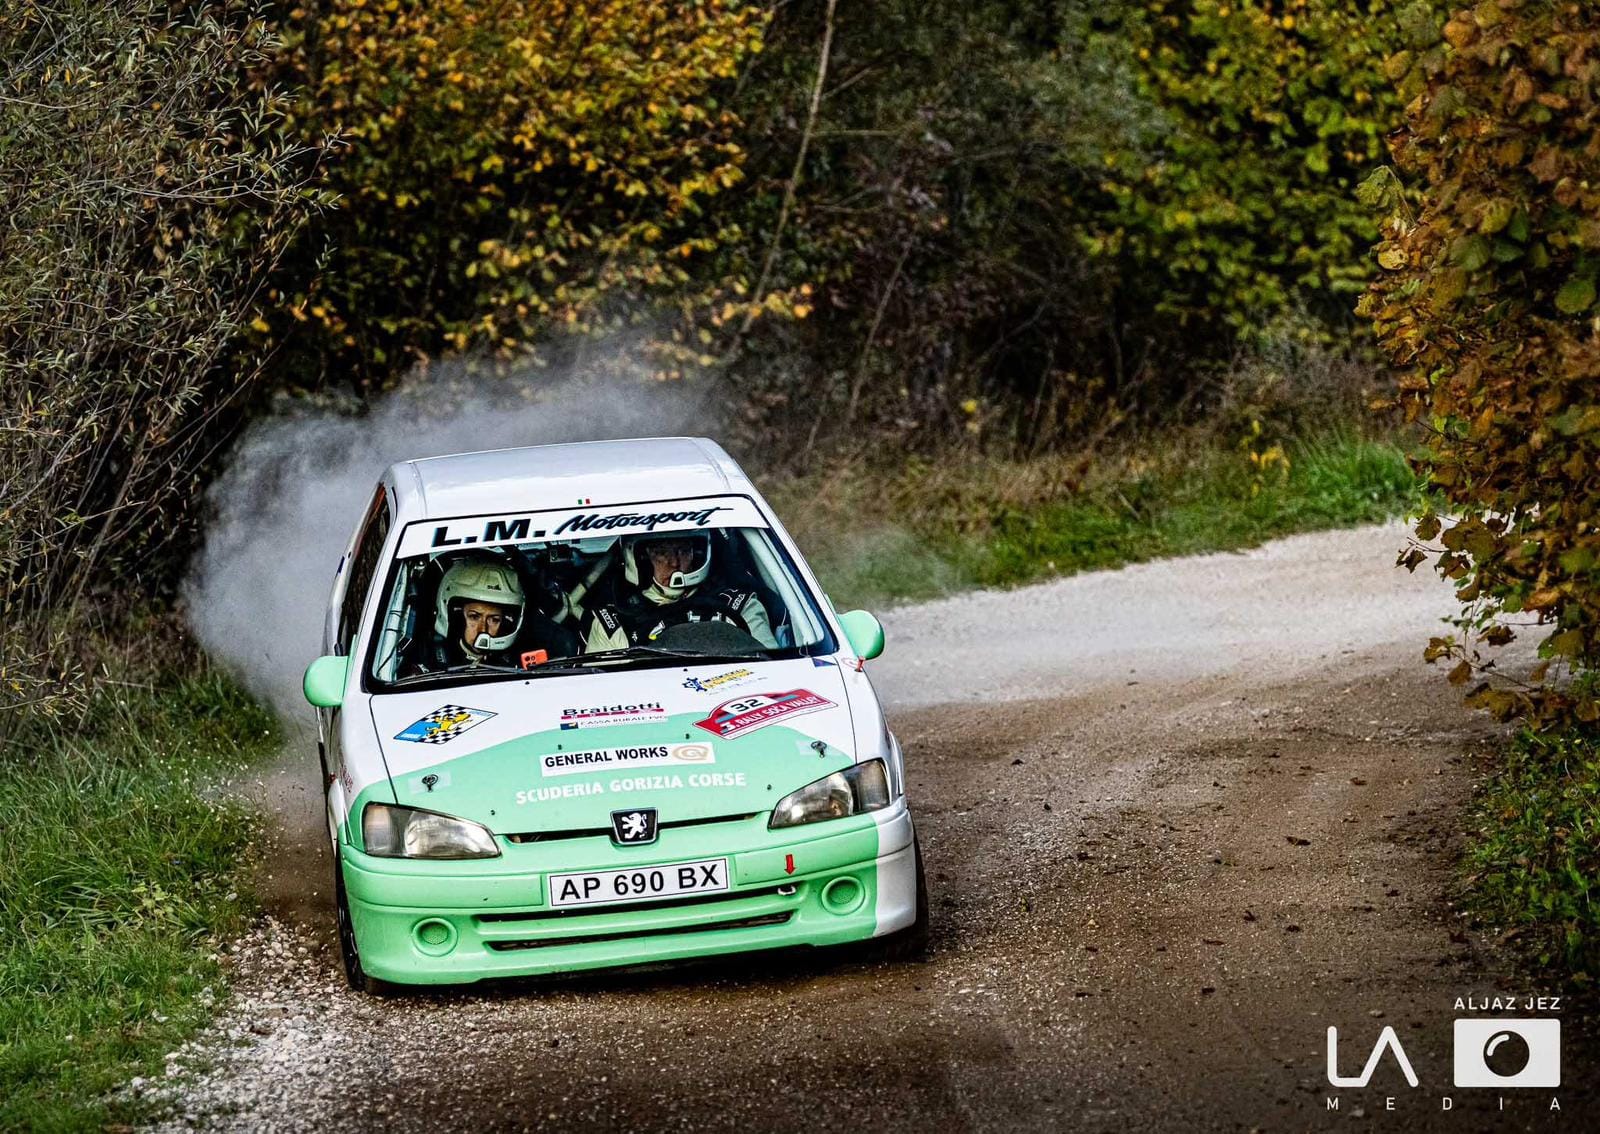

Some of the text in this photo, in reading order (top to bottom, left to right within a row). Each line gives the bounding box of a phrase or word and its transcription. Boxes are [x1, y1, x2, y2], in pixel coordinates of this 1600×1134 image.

[431, 507, 734, 548] L.M. Motorsport
[563, 702, 660, 716] Braidotti
[731, 699, 764, 712] 32
[735, 712, 765, 725] RALLY
[785, 696, 821, 708] VALLEY
[545, 750, 612, 768] GENERAL
[615, 746, 668, 761] WORKS
[516, 772, 747, 805] SCUDERIA GORIZIA CORSE
[559, 863, 719, 901] AP 690 BX
